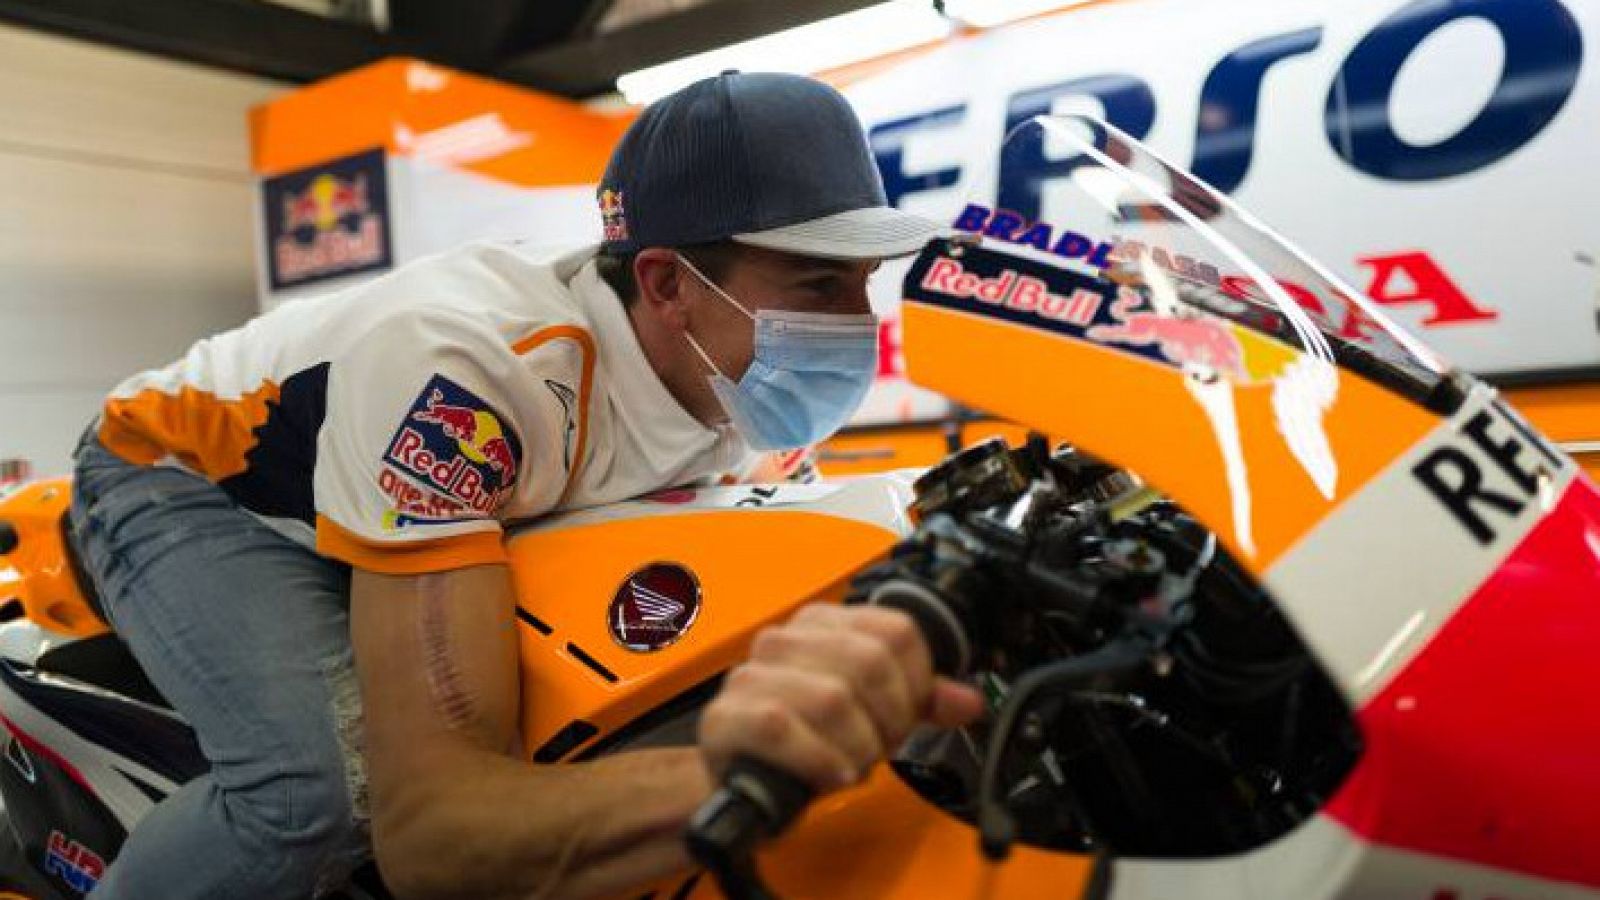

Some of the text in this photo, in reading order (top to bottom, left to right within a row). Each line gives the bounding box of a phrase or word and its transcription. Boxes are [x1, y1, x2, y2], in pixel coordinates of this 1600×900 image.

[921, 256, 1103, 327] Red Bull
[391, 427, 467, 489] Red
